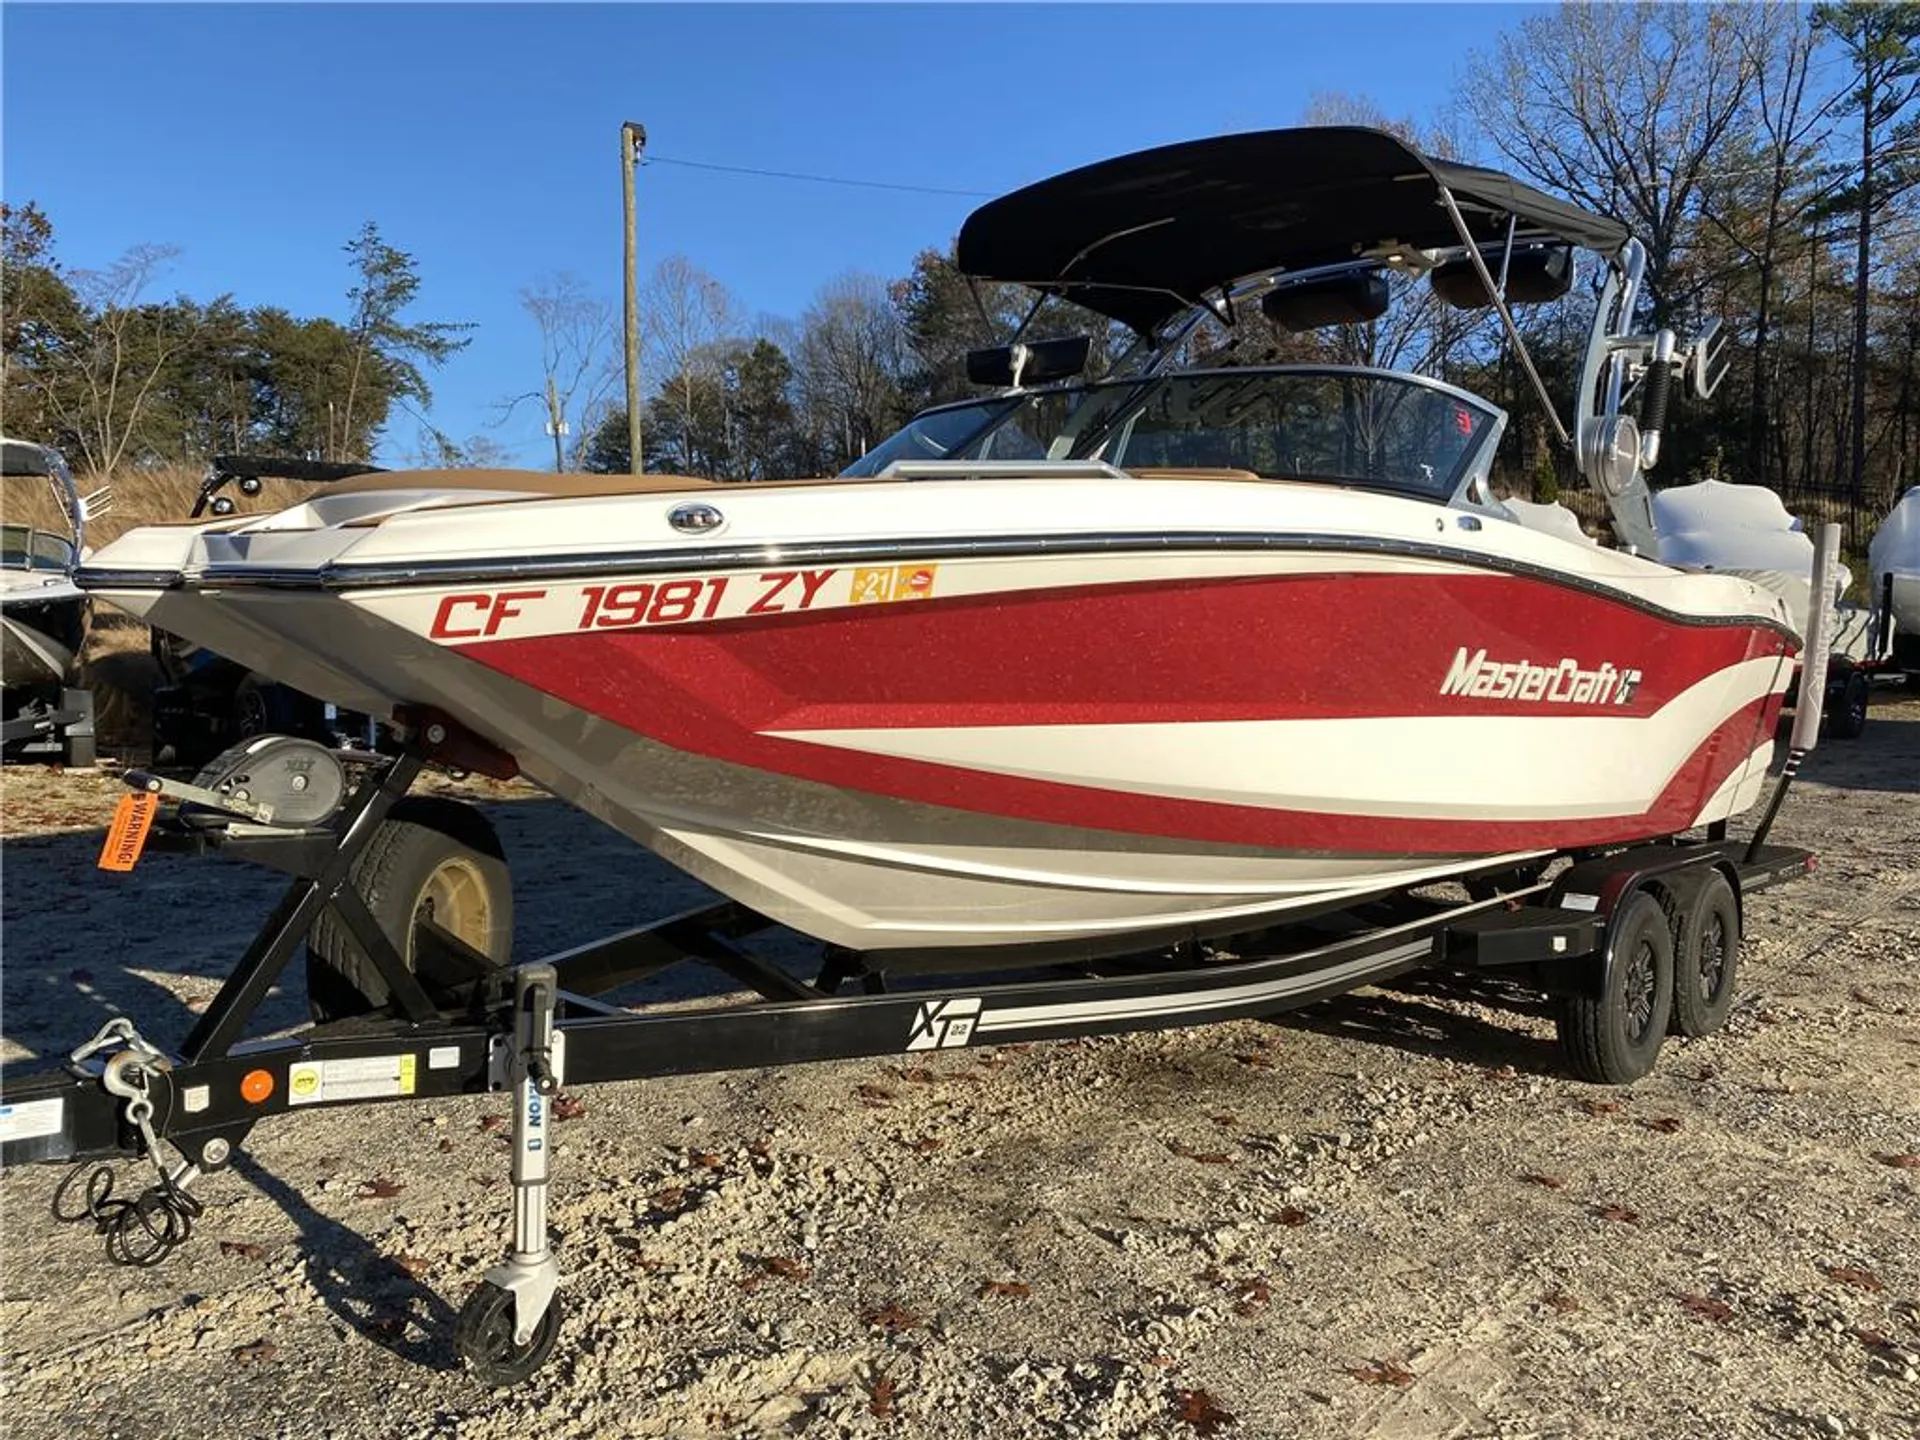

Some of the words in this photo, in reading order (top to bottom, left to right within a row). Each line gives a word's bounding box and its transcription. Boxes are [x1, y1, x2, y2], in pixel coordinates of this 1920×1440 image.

[429, 590, 547, 639] CF
[578, 577, 729, 630] 1981
[745, 568, 839, 615] ZY
[862, 571, 890, 600] 21
[1440, 646, 1617, 704] MasterCraft
[116, 803, 148, 864] WARNING!
